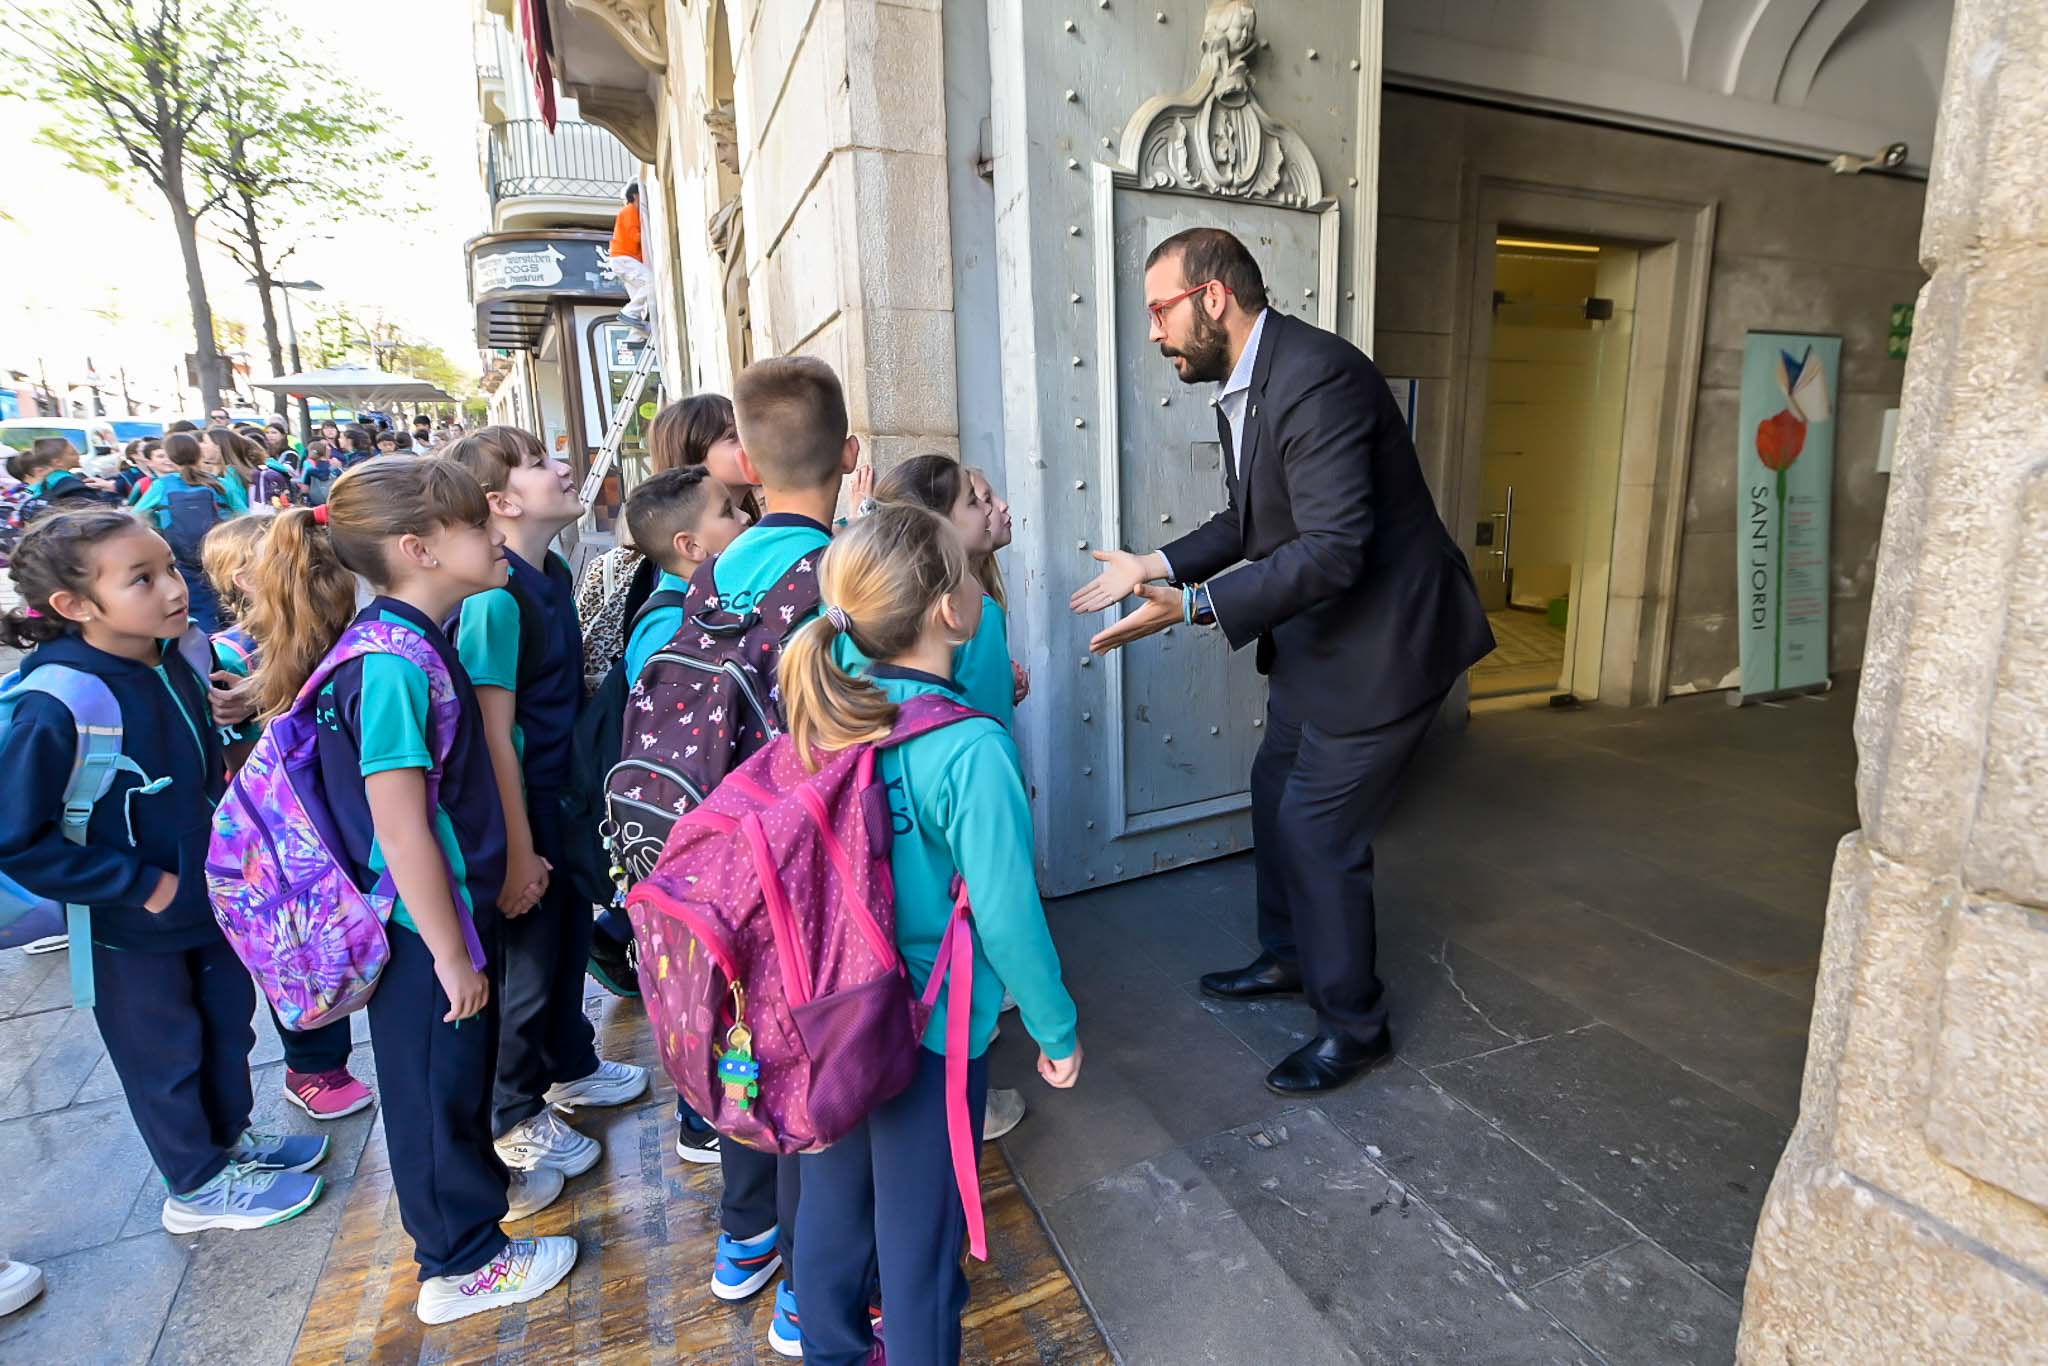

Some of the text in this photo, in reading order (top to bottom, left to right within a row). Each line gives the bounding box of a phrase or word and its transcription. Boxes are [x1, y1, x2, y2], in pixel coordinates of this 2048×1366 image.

[504, 263, 540, 275] DOGS
[1751, 485, 1769, 630] SANT JORDI
